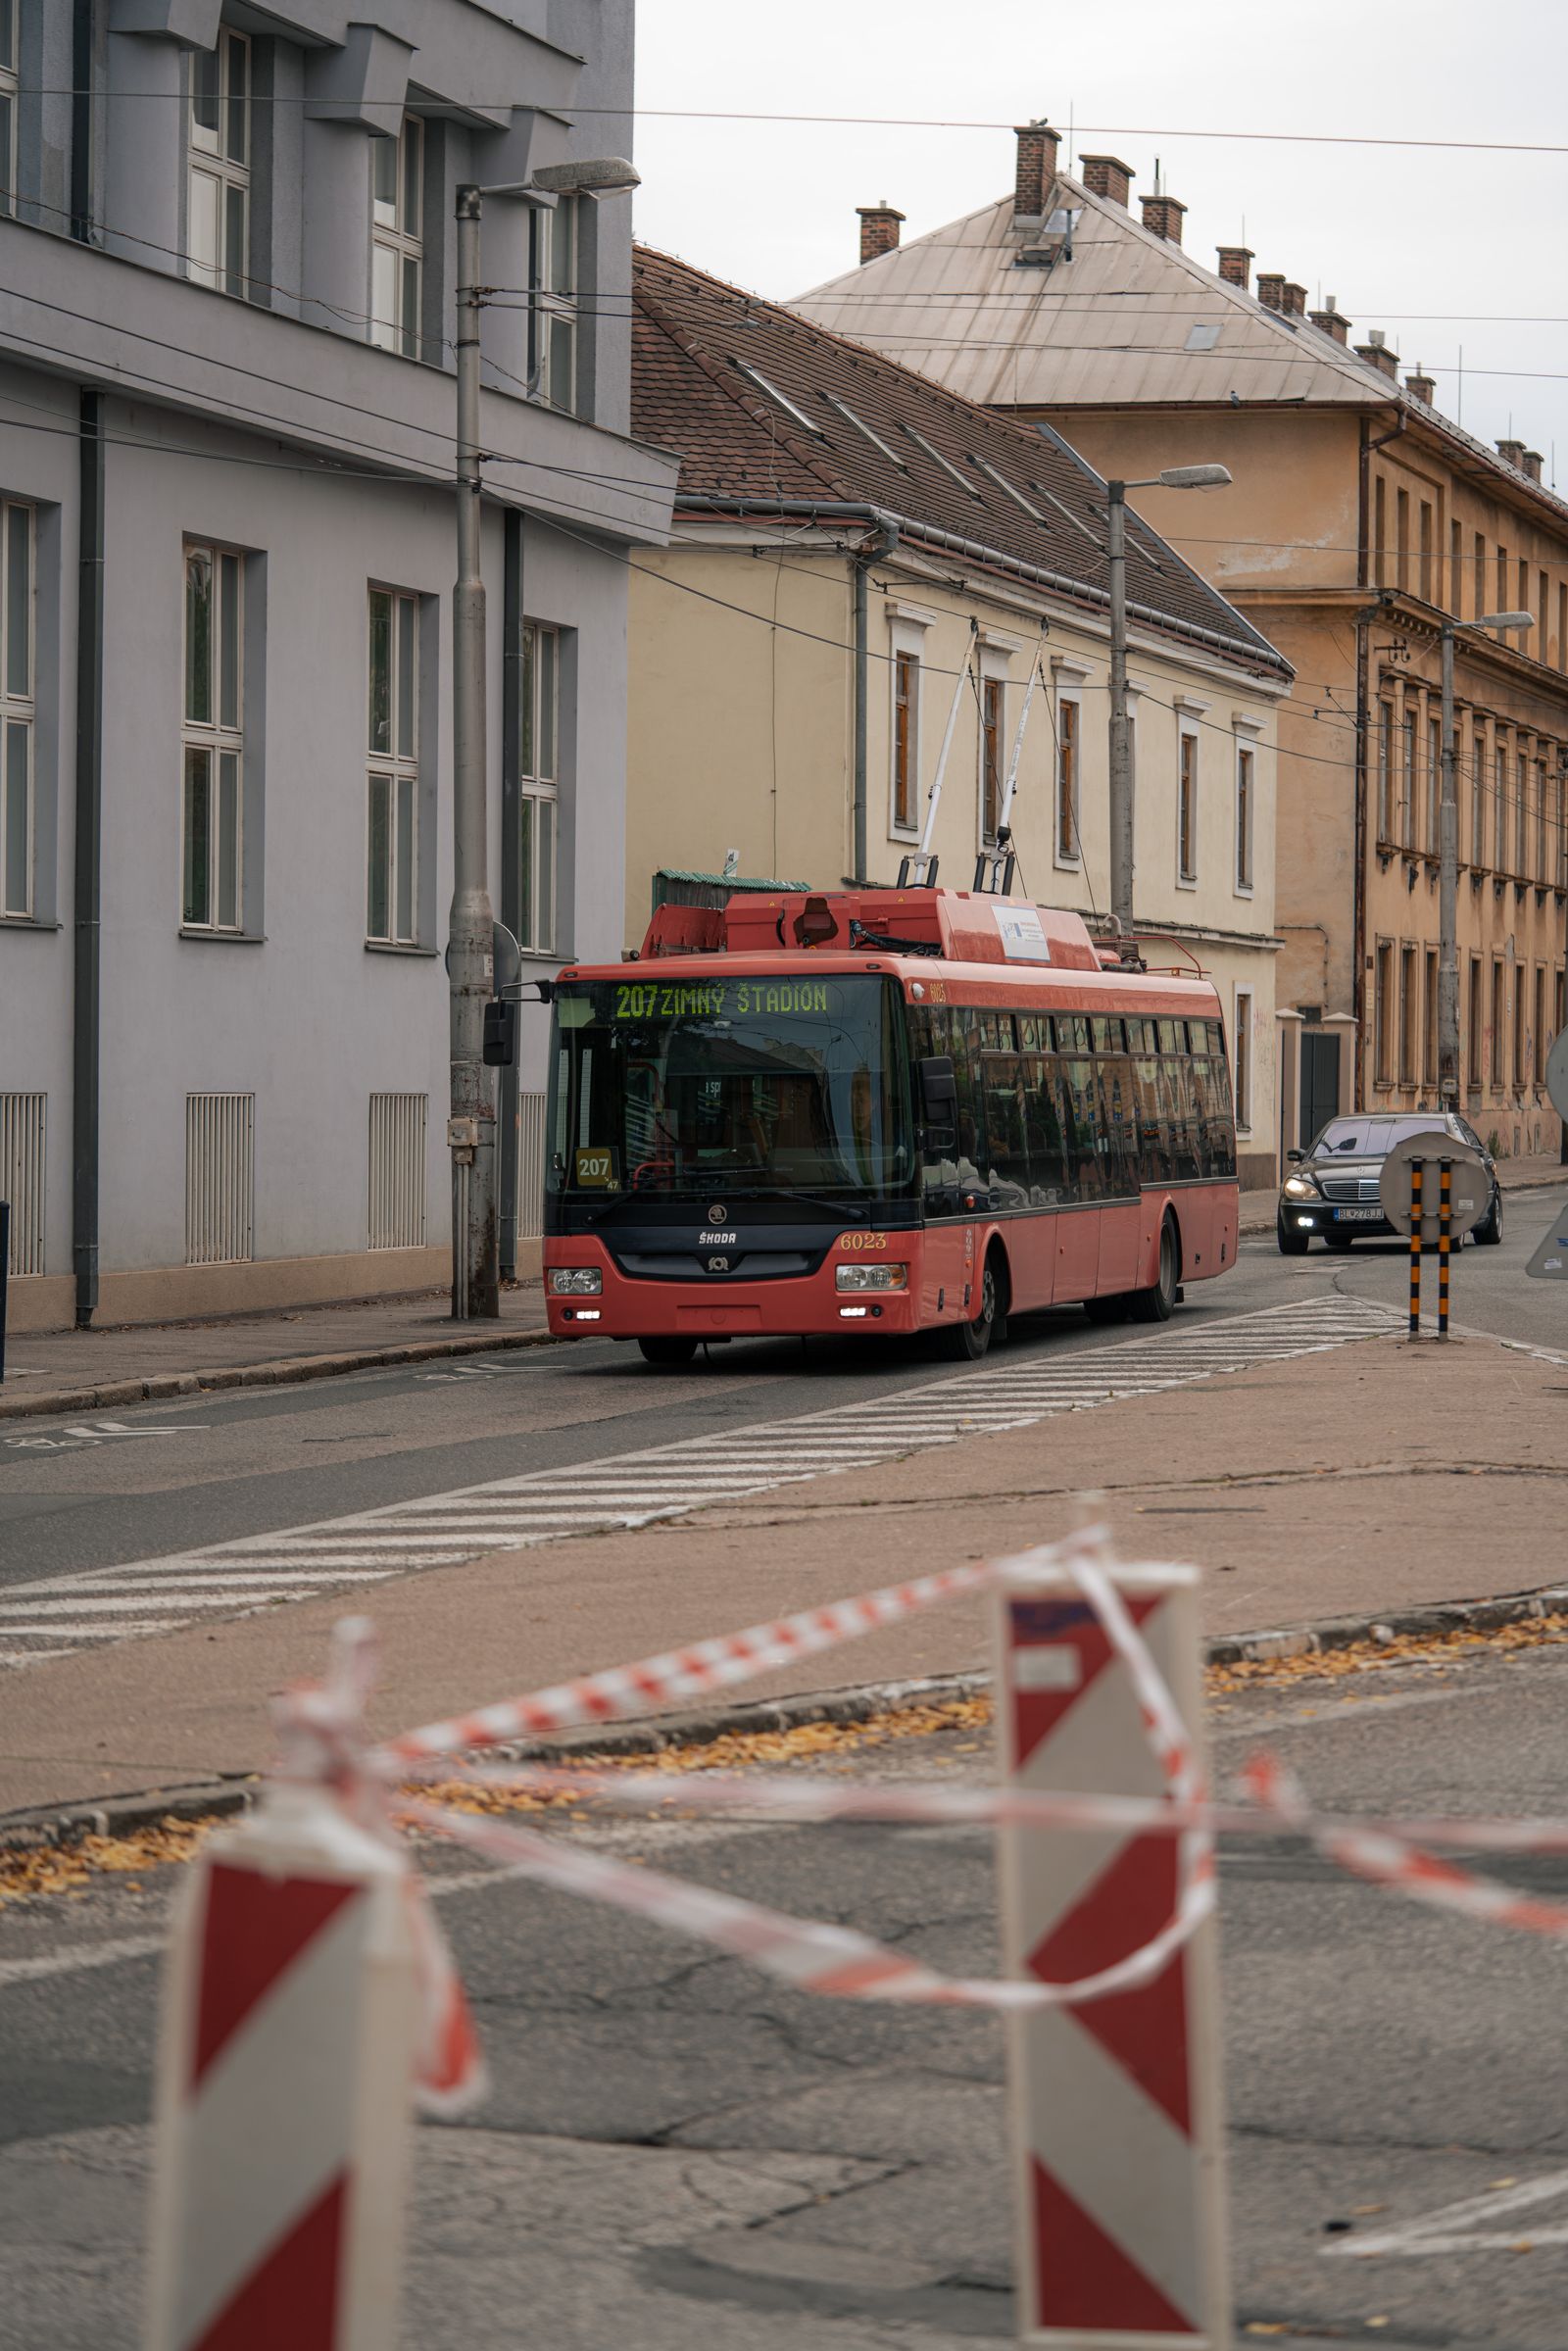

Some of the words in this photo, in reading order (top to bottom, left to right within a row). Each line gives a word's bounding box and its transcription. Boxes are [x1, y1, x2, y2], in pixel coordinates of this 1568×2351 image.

[616, 985, 658, 1018] 207
[661, 984, 725, 1015] ZIMNÝ
[737, 982, 827, 1012] ŠTADIÓN
[579, 1158, 609, 1176] 207
[699, 1231, 737, 1245] ŠKODA
[840, 1233, 887, 1250] 6023
